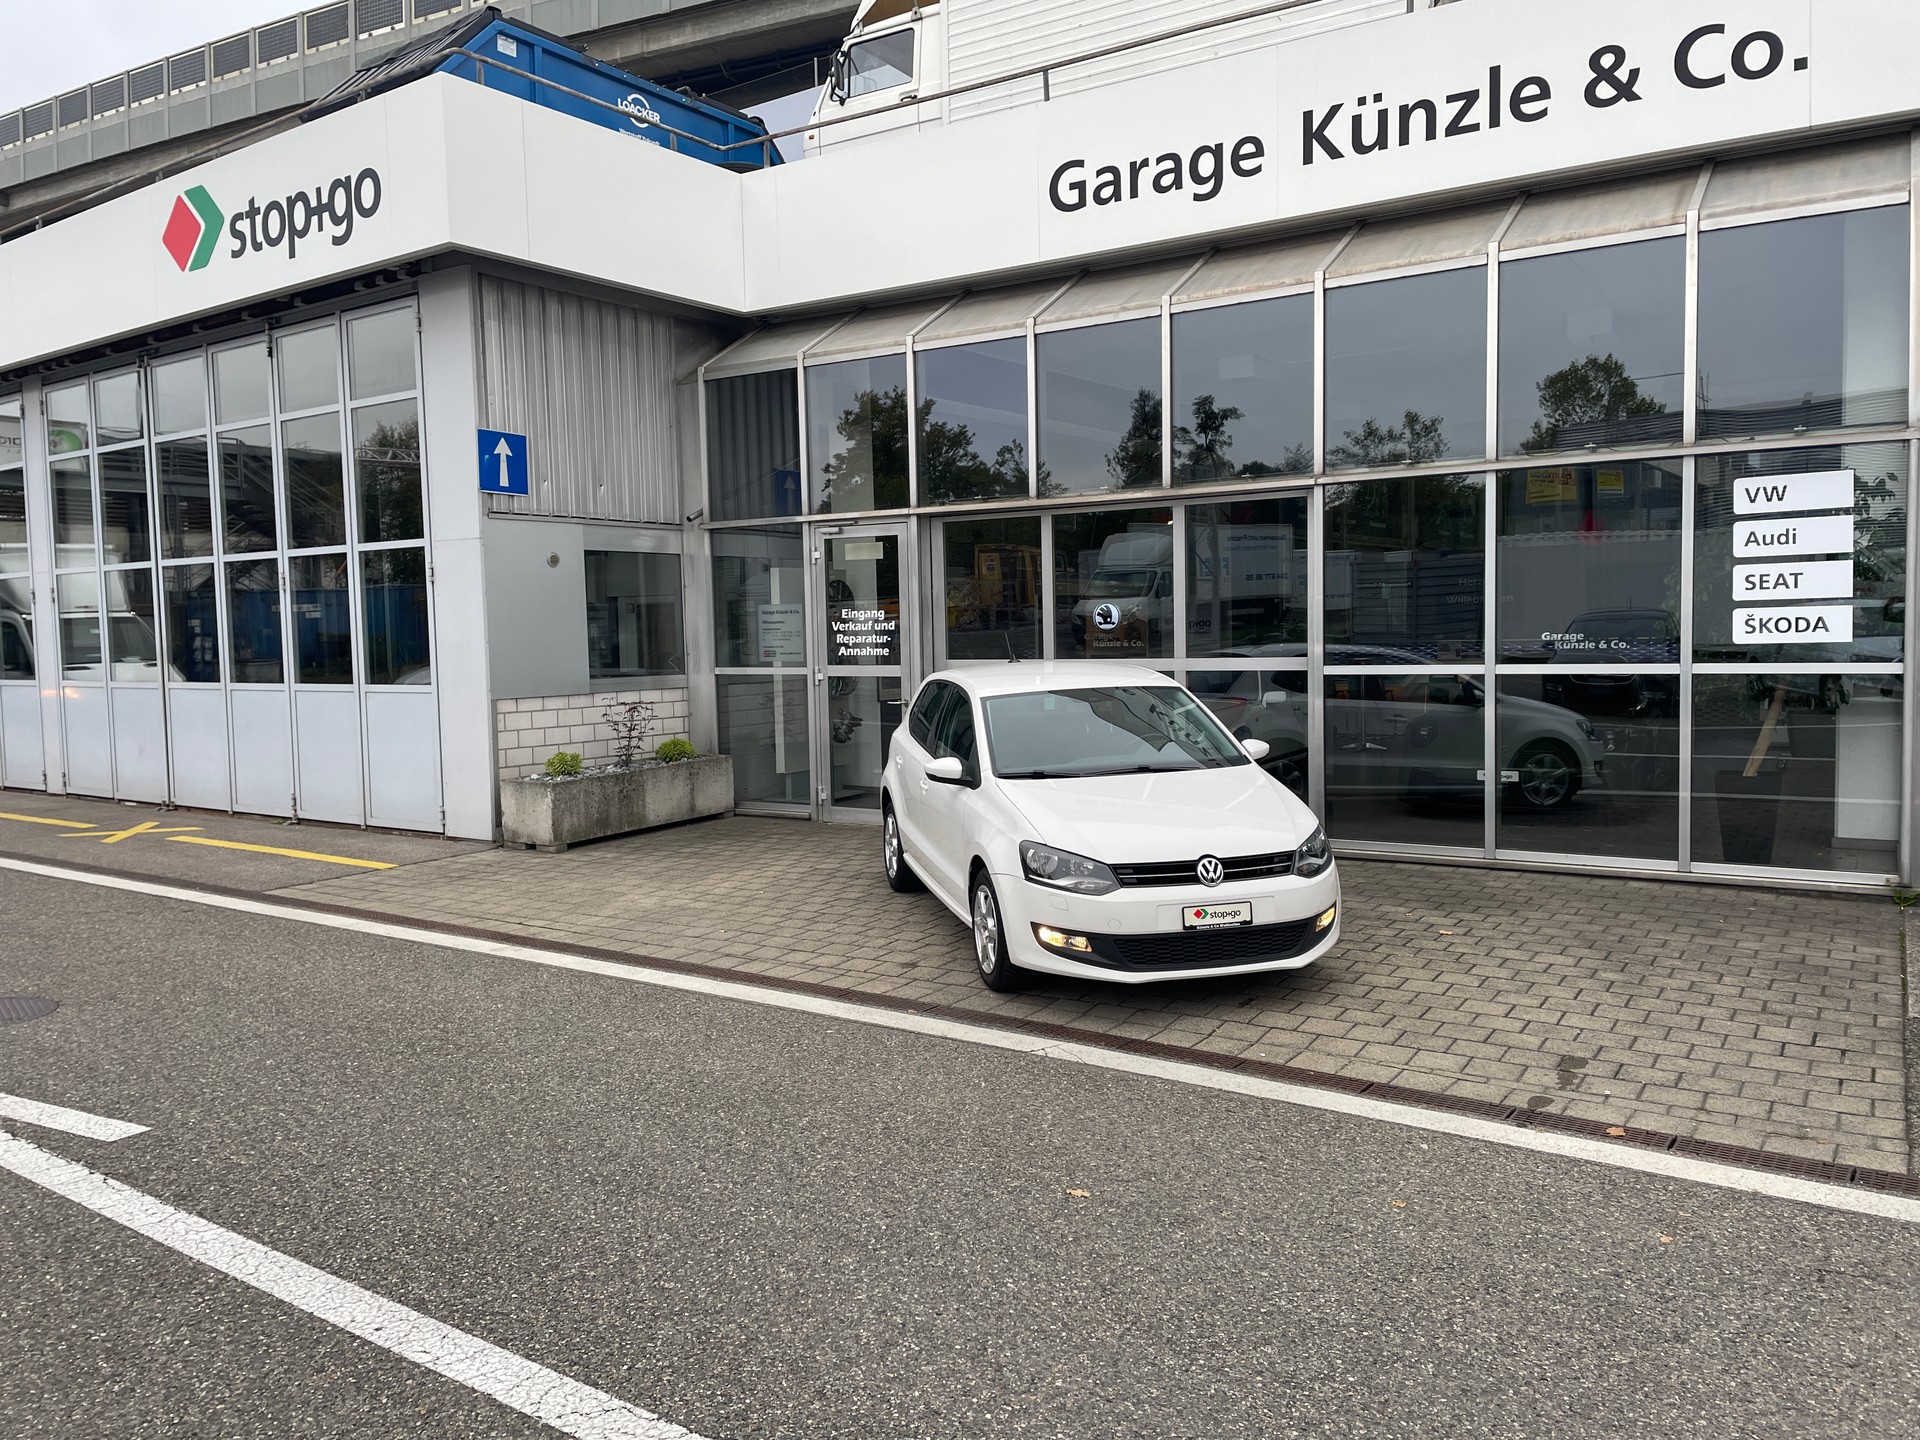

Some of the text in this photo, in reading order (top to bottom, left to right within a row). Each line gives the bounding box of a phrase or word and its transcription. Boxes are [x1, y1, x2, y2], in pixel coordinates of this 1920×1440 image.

[617, 97, 660, 123] LOACKER
[1049, 23, 1809, 212] Garage Künzle & Co.
[229, 167, 382, 260] stop+go
[1745, 484, 1788, 503] VW
[1744, 528, 1797, 547] Audi
[1744, 572, 1804, 591] SEAT
[841, 608, 885, 621] Eingang
[831, 620, 896, 631] Verkauf und
[1744, 614, 1830, 634] ŠKODA
[836, 633, 892, 647] Reparatur-
[1541, 631, 1585, 643] Garage
[1554, 640, 1631, 650] Künzle & Co.
[838, 646, 890, 656] Annahme
[1209, 909, 1242, 920] stop+go
